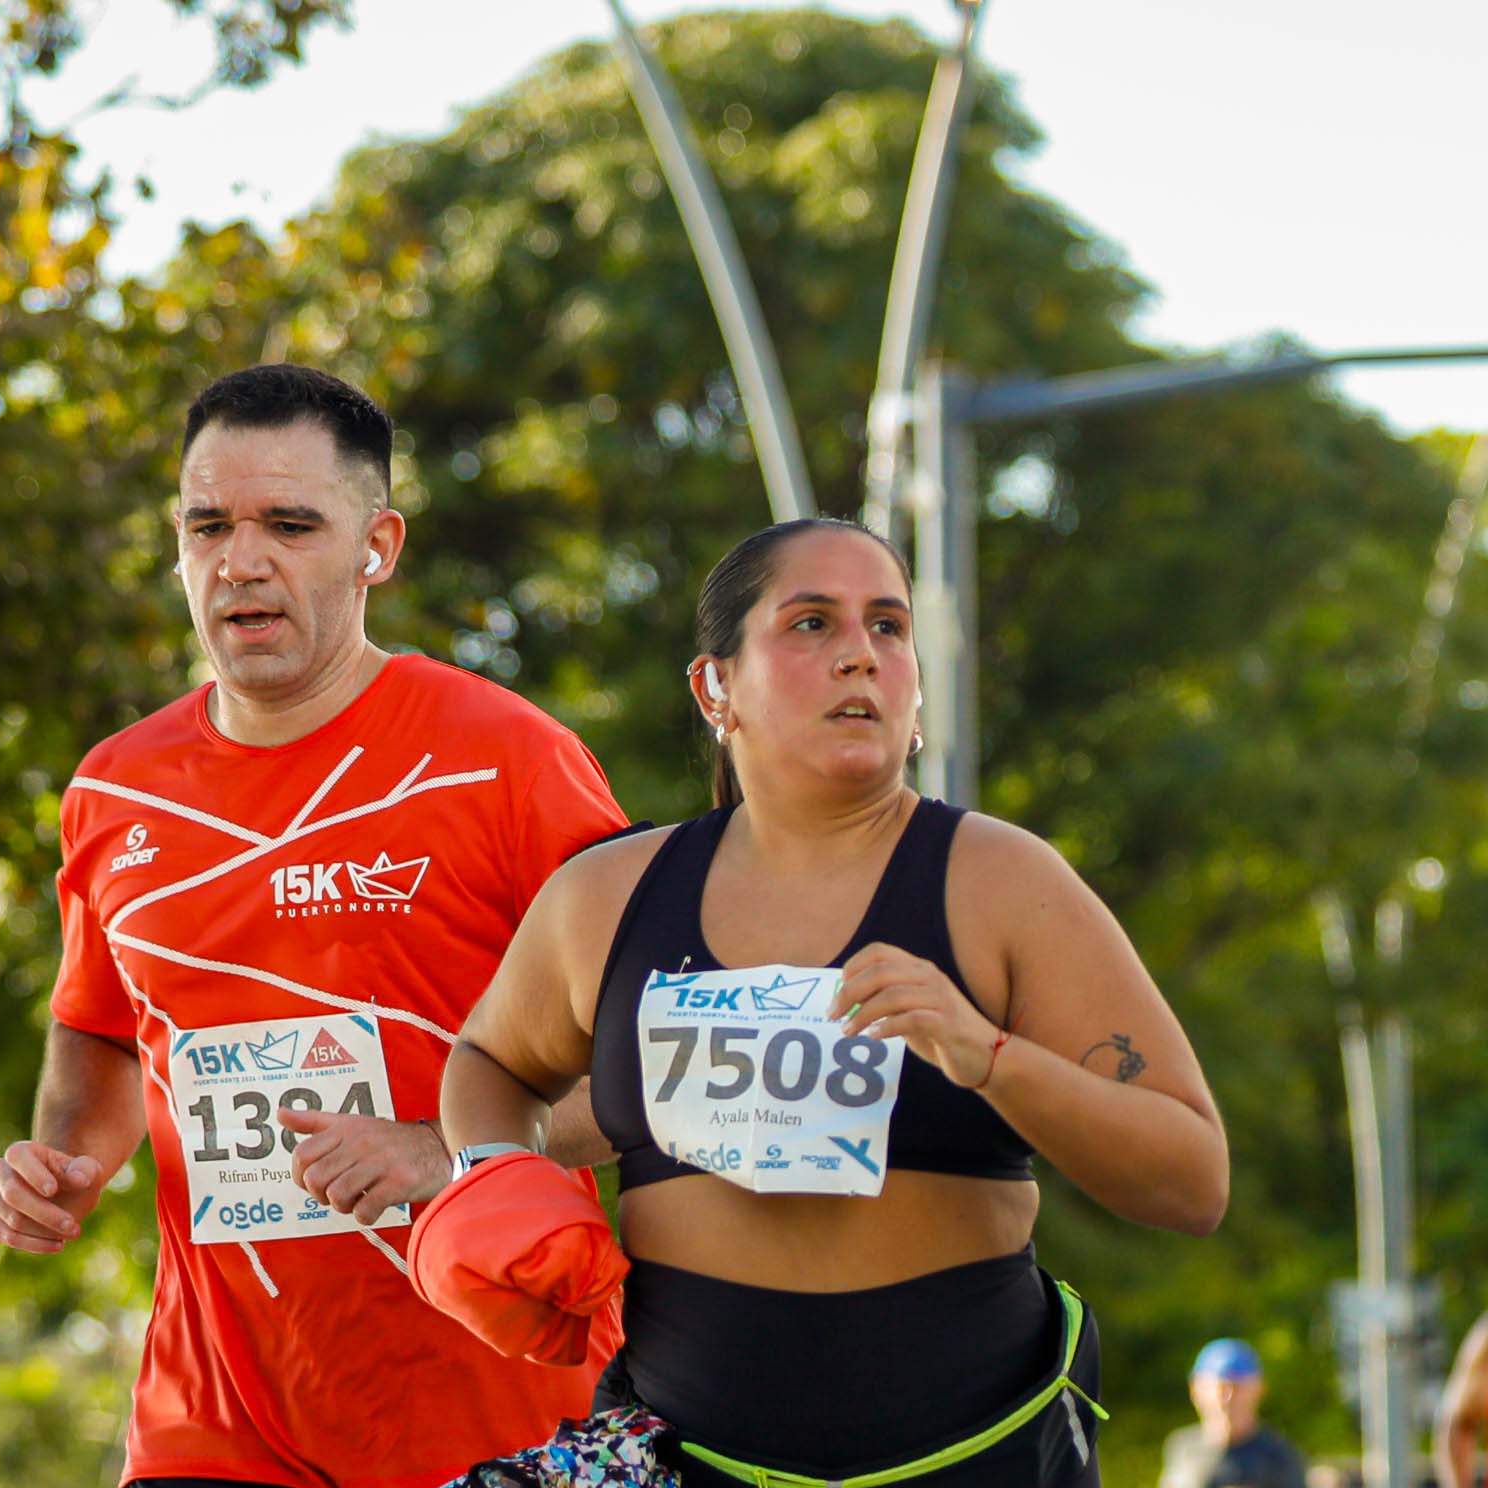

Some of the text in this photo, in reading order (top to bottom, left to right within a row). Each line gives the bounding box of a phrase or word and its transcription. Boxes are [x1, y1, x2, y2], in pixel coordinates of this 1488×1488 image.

[270, 863, 343, 905] 15K
[276, 902, 411, 918] PUERTO NORTE
[675, 986, 744, 1011] 15K
[186, 1042, 247, 1076] 15K
[311, 1046, 343, 1063] 15K
[648, 1026, 889, 1108] 7508
[709, 1108, 803, 1128] Ayala Malen
[218, 1168, 259, 1184] Rifrani
[218, 1198, 284, 1229] osde
